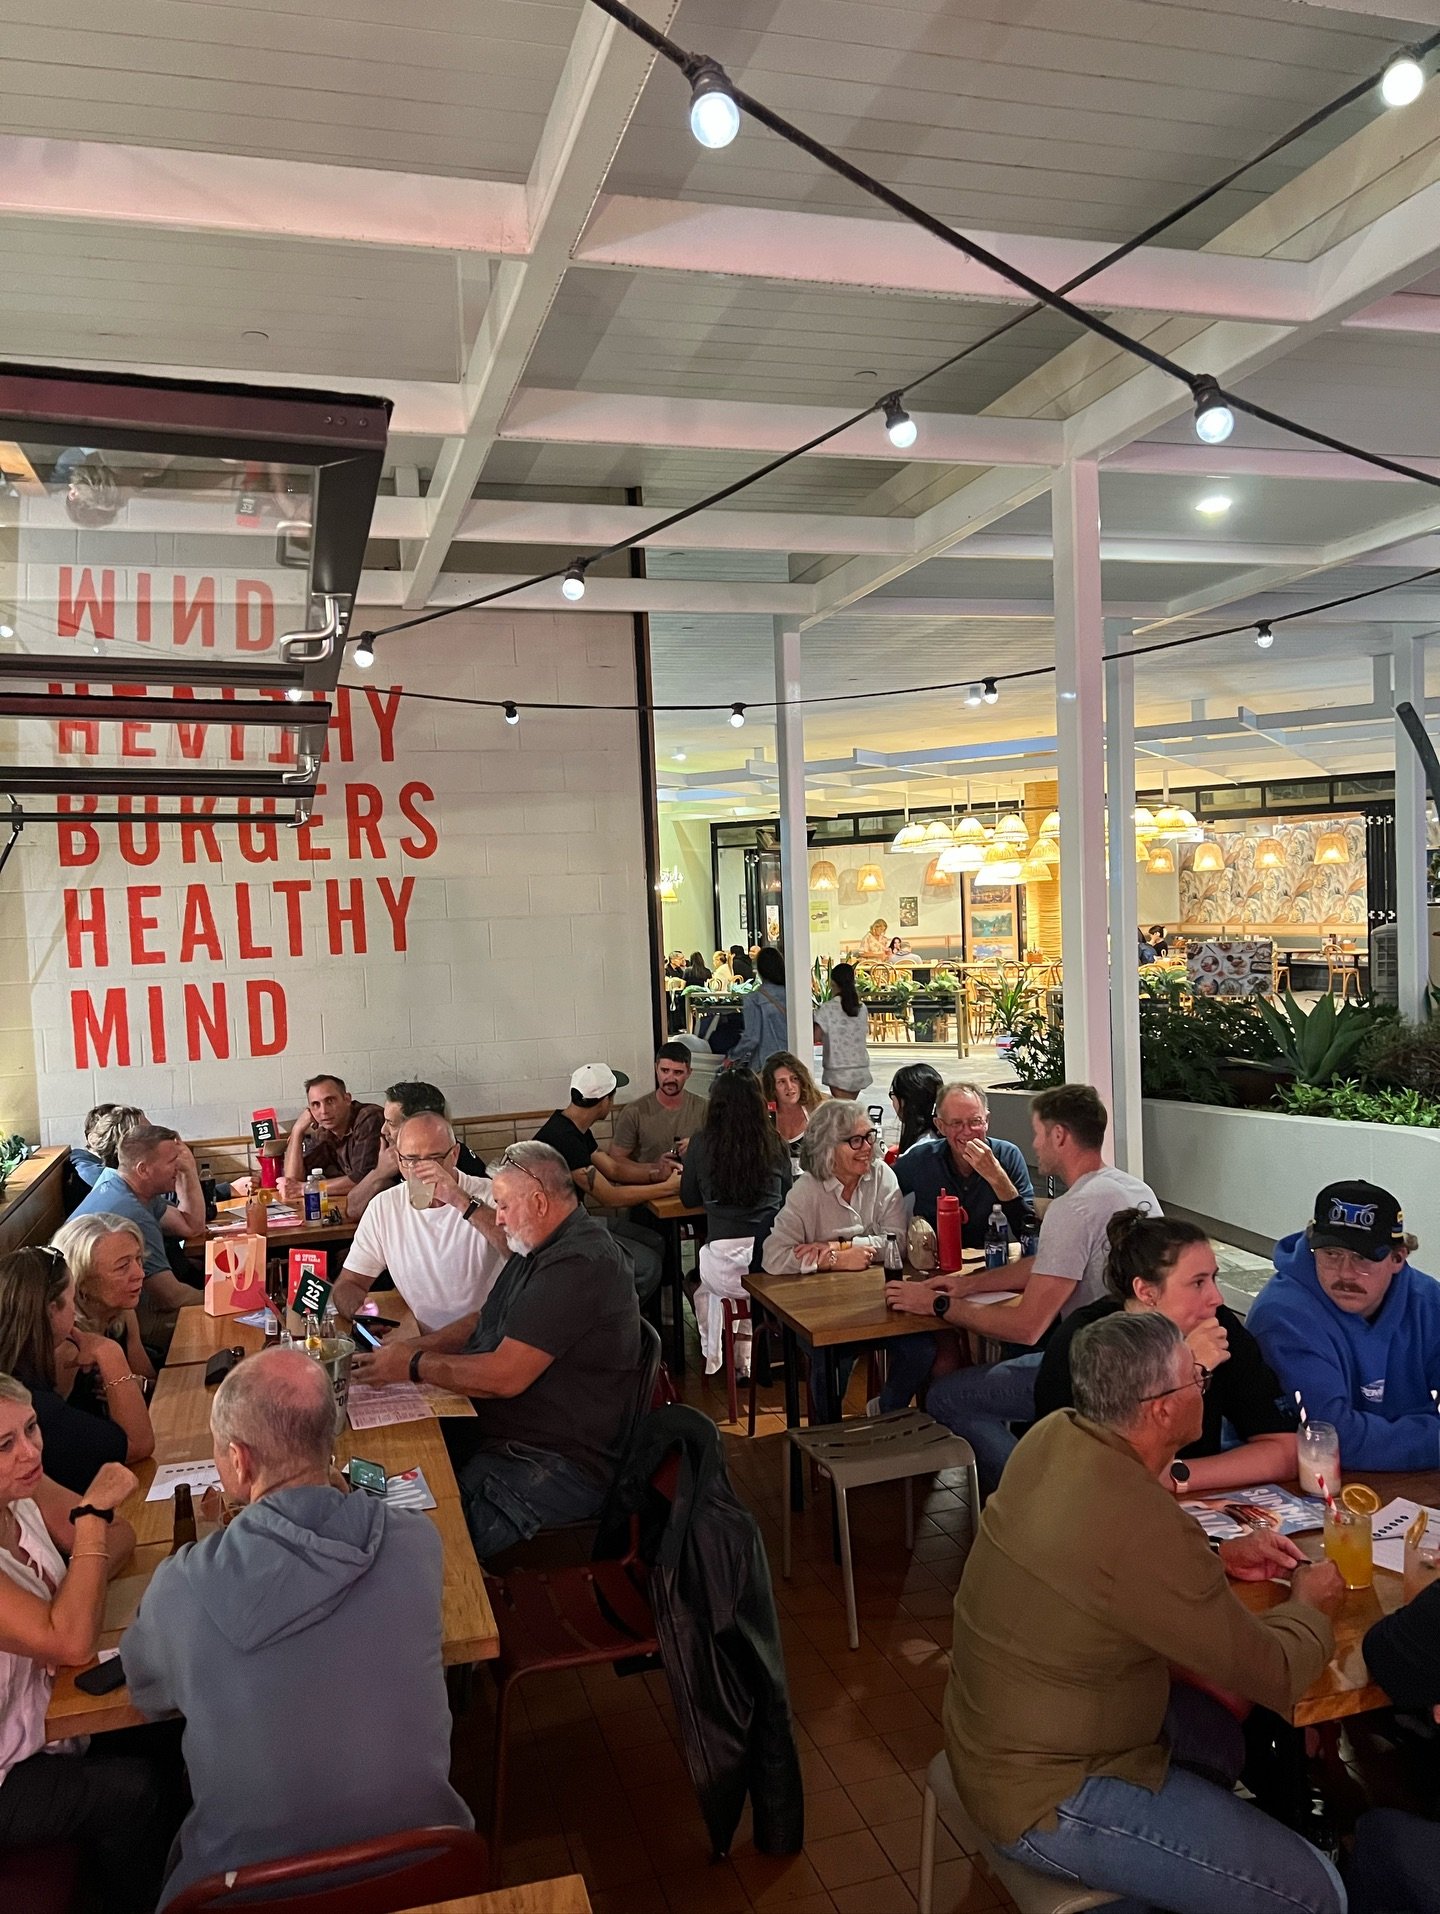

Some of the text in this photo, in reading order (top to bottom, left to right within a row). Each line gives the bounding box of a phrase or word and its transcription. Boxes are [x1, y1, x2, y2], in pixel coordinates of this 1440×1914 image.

[48, 684, 402, 762] HEHY
[57, 781, 438, 867] BURGERS
[63, 876, 416, 969] HEALTHY
[70, 979, 289, 1070] MIND
[305, 1285, 320, 1302] 22
